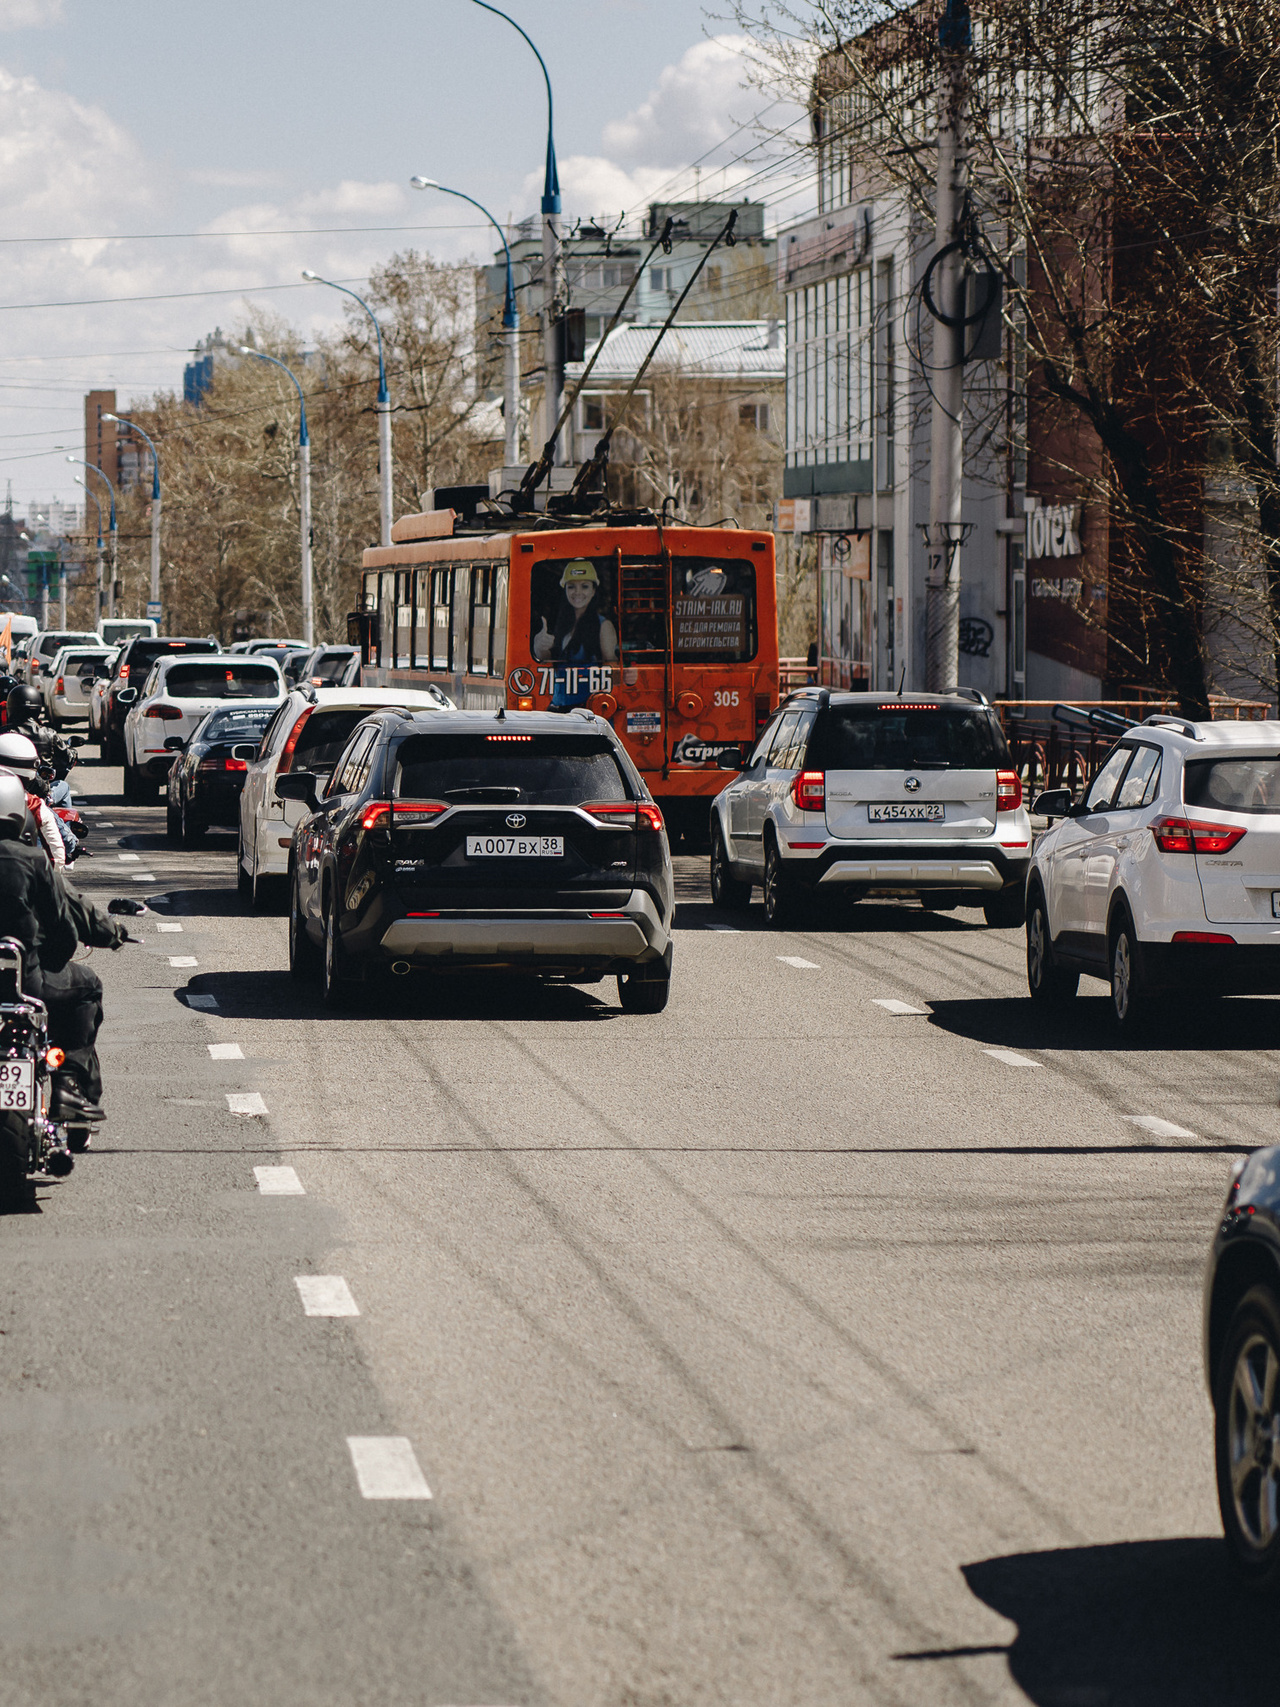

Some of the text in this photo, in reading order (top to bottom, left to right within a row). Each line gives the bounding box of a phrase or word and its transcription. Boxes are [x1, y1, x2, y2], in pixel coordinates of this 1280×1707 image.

[929, 554, 942, 570] 17
[675, 600, 743, 616] STRIM-IRK.RU
[709, 621, 741, 633] РЕМОНТА
[684, 636, 739, 648] СТРОИТЕЛЬСТВА
[537, 665, 612, 695] 71-11-66
[713, 690, 740, 707] 305
[685, 746, 738, 761] стри
[874, 805, 940, 818] К454ХК 22
[473, 838, 558, 854] А007ВХ 38
[0, 1082, 17, 1090] RUS
[4, 1090, 27, 1107] 38
